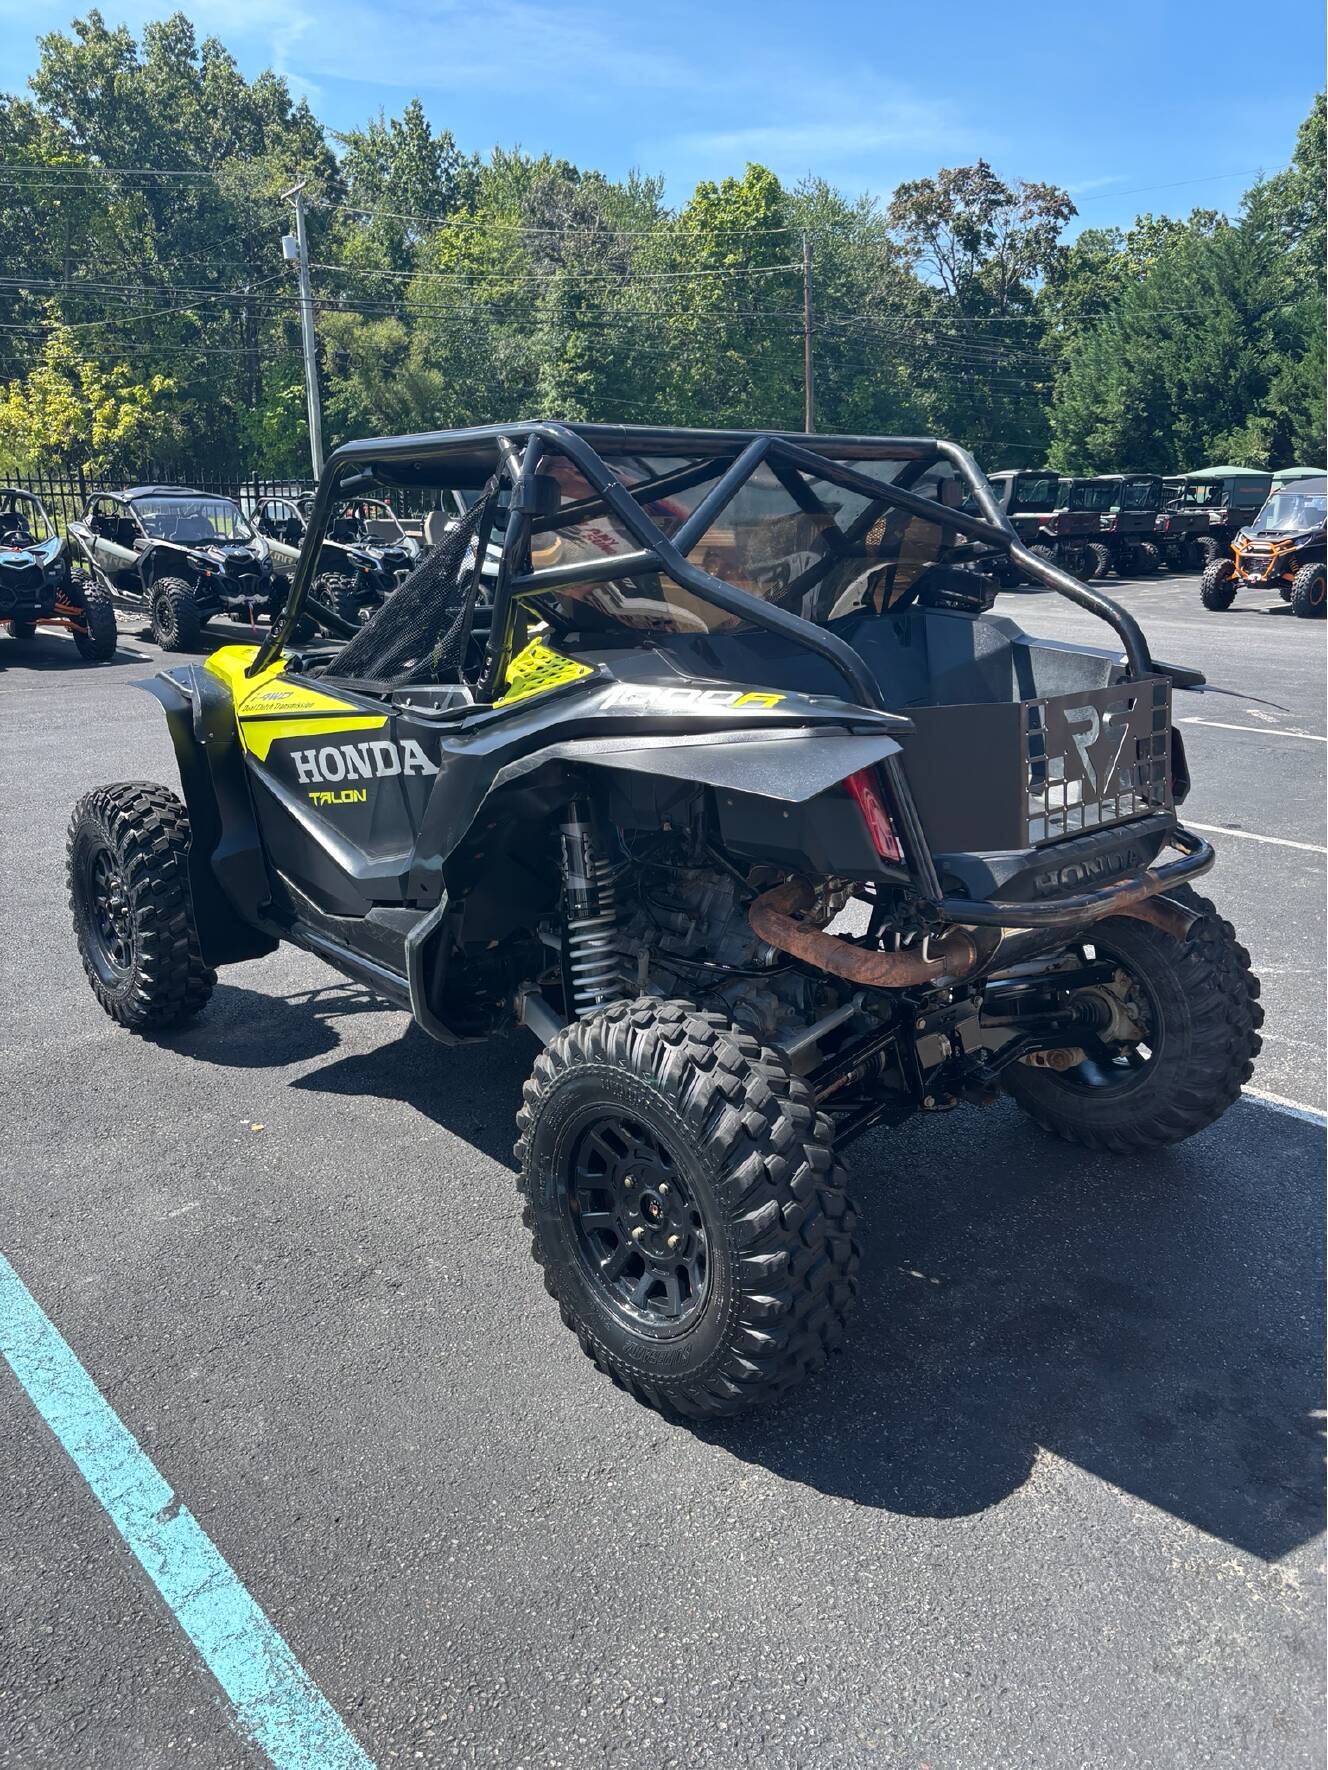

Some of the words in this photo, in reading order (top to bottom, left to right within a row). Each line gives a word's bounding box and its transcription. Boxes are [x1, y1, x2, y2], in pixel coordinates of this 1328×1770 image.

[274, 702, 315, 710] Transmission
[290, 740, 440, 784] HONDA
[309, 789, 367, 807] TALON
[1033, 850, 1140, 892] HONDA
